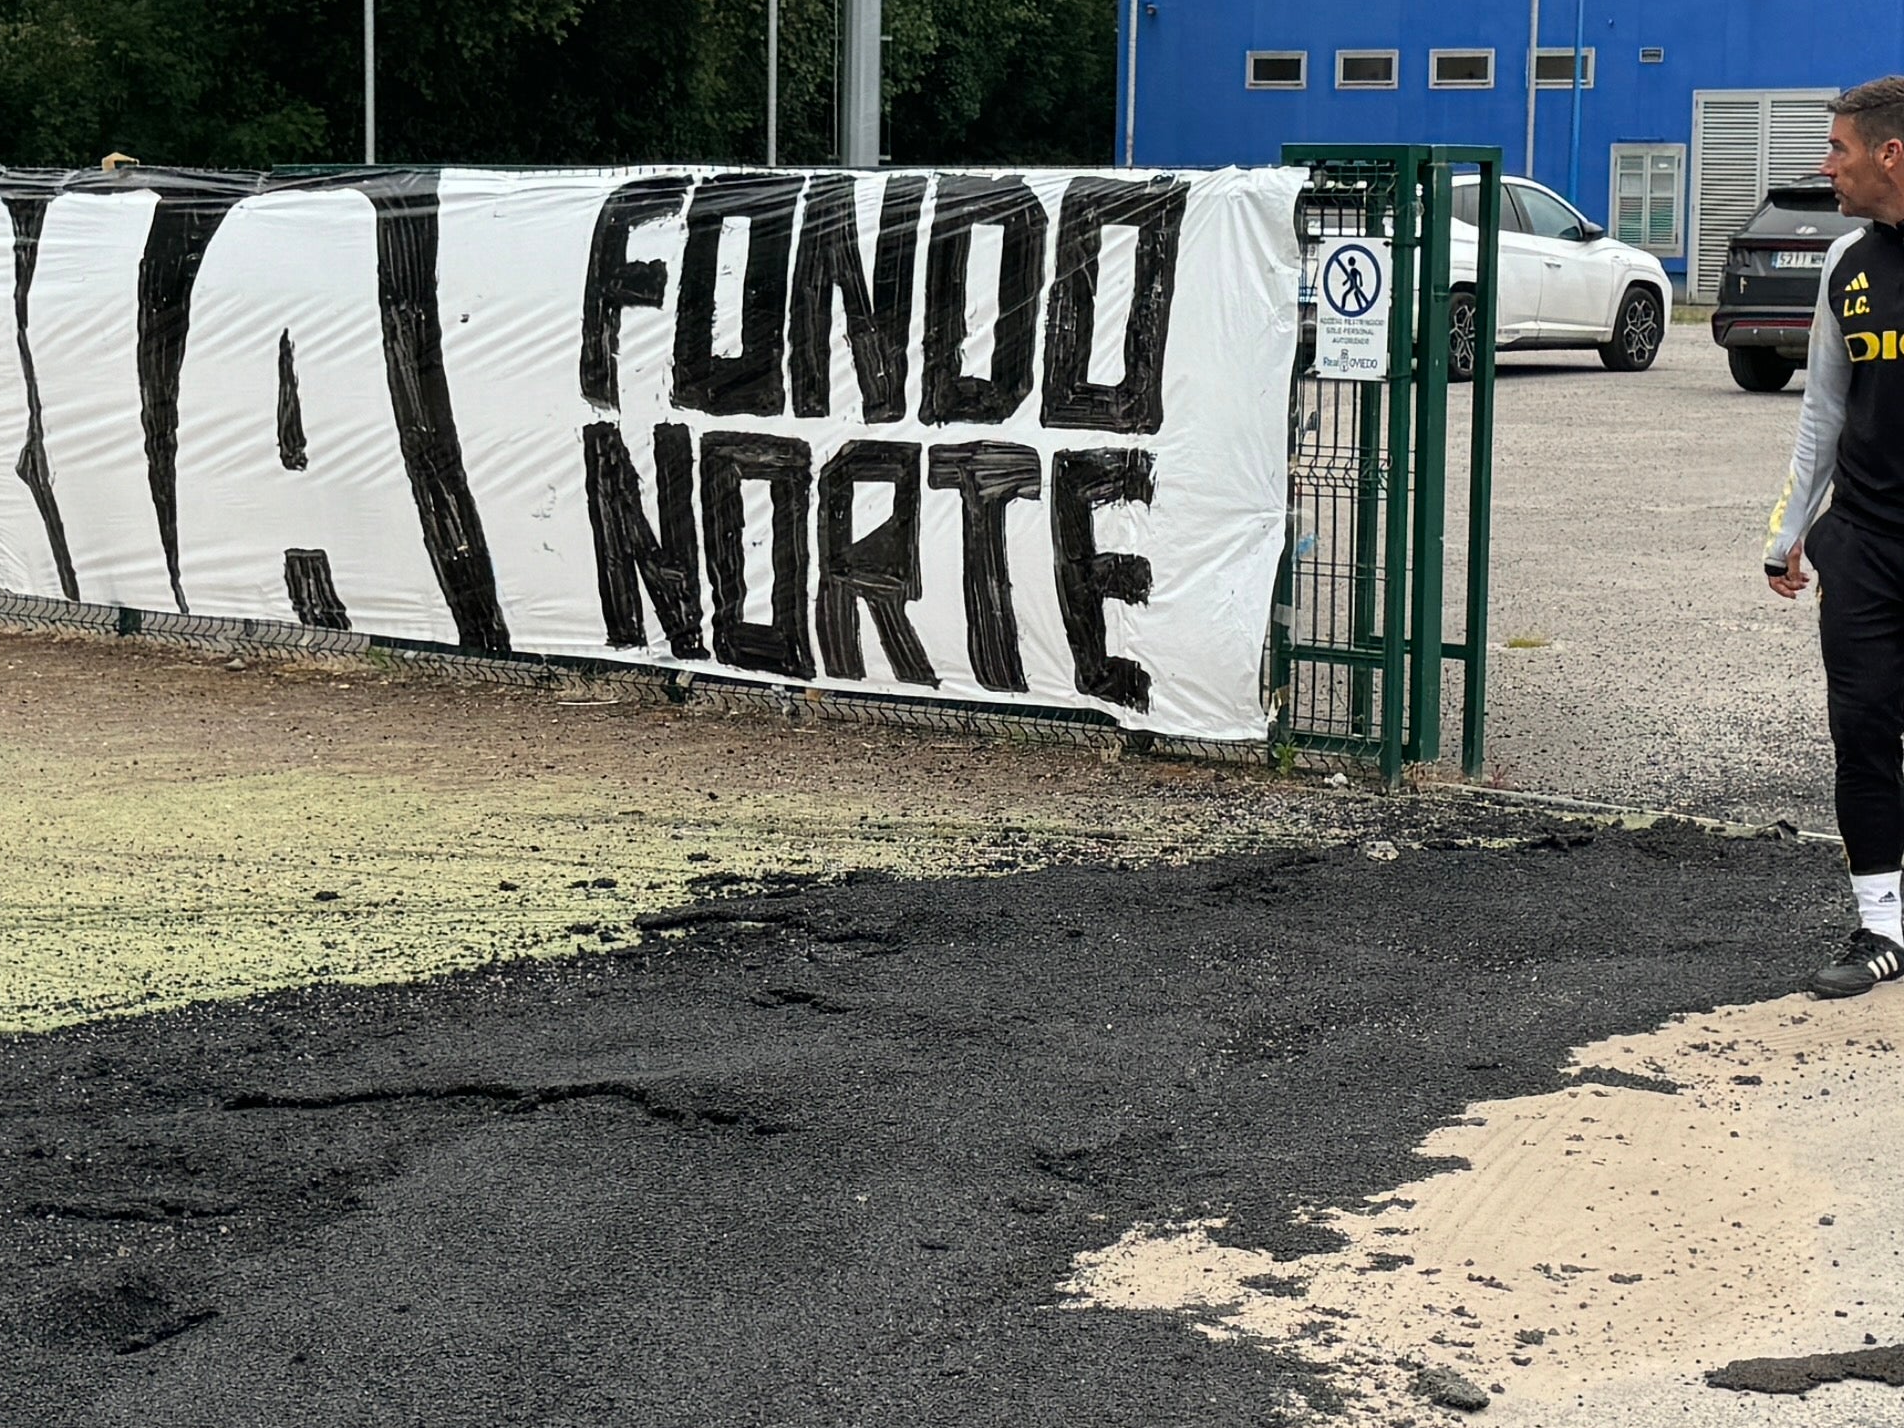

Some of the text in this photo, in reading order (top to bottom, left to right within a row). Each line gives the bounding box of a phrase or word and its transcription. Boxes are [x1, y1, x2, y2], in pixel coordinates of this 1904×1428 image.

[580, 171, 1192, 436] FONDO
[1349, 358, 1378, 369] OVIEDO
[582, 421, 1158, 713] NORTE
